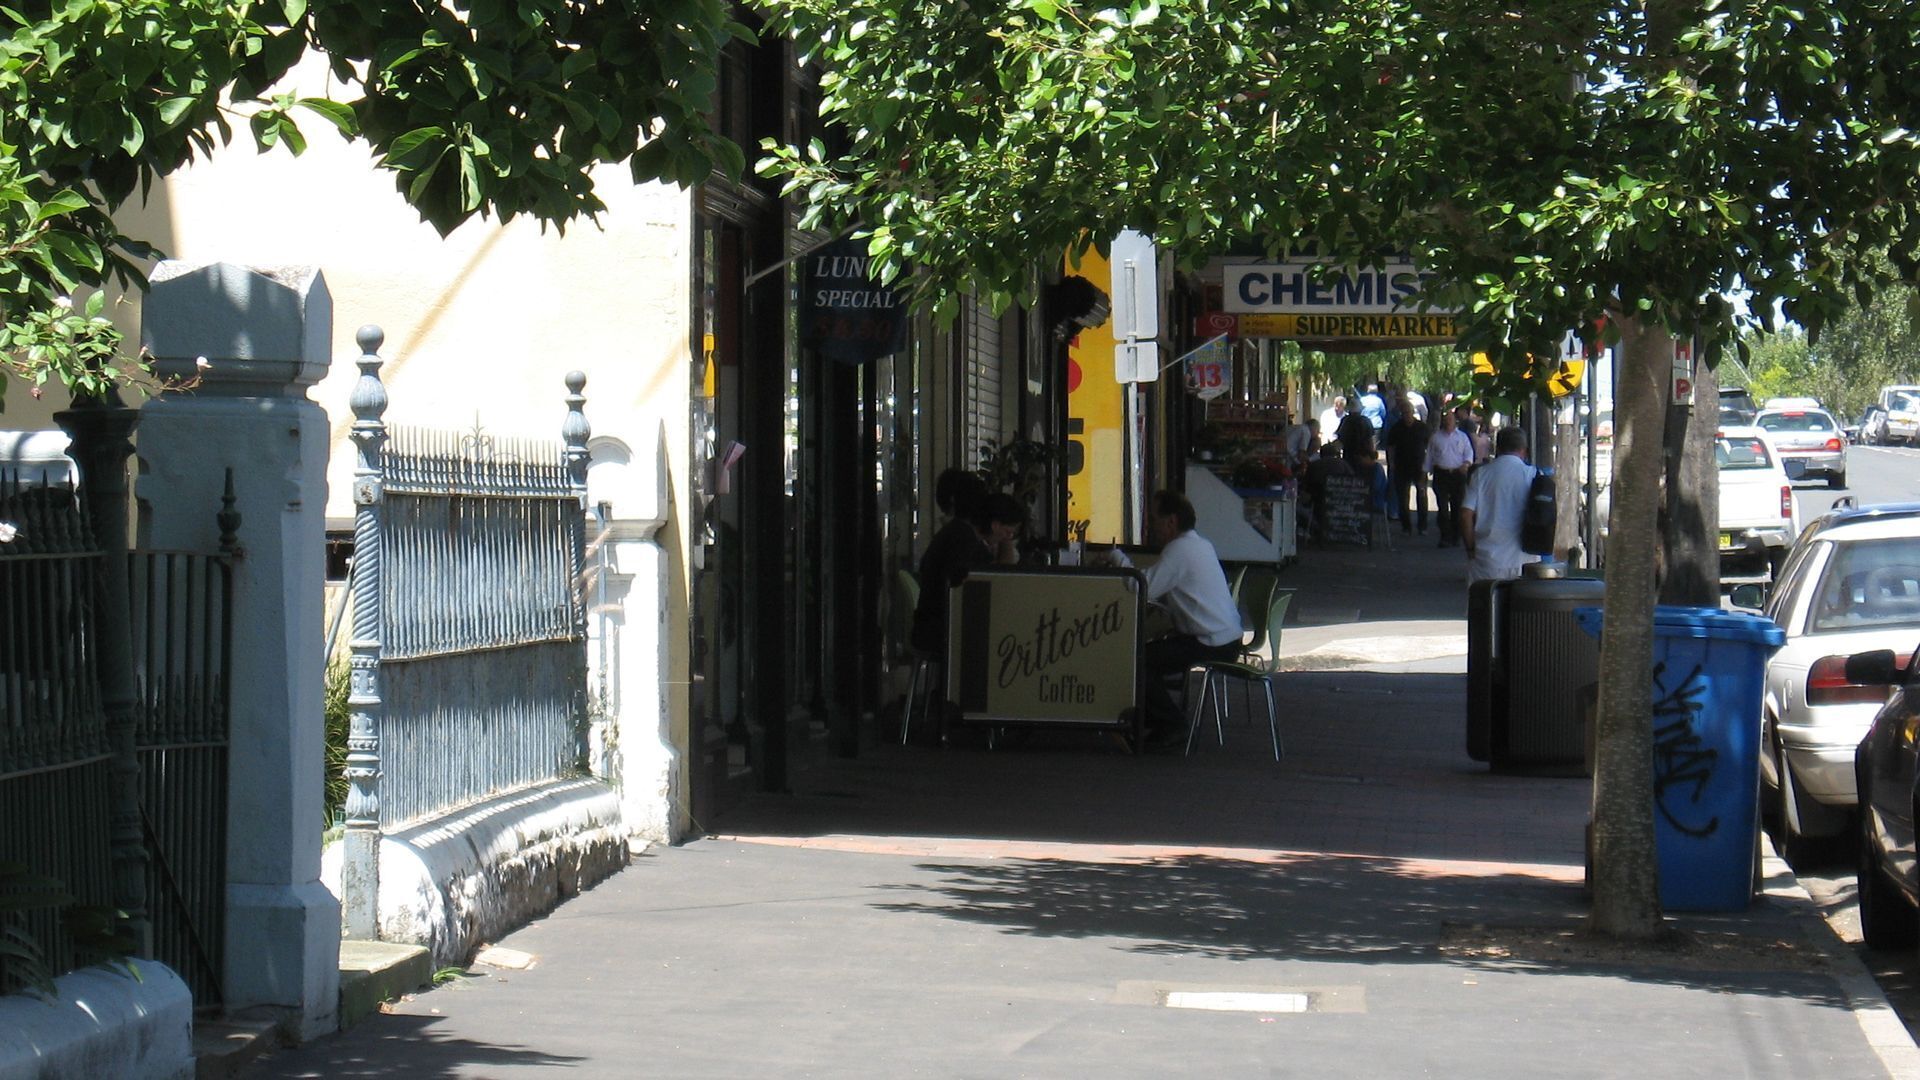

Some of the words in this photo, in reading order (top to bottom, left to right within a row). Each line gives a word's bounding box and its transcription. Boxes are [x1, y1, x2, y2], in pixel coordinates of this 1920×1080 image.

[815, 255, 871, 278] LUN
[815, 289, 896, 309] SPECIAL
[1238, 271, 1442, 306] CHEMIS
[1196, 364, 1222, 389] 13
[997, 599, 1124, 689] Vittoria
[1038, 674, 1096, 704] Coffee
